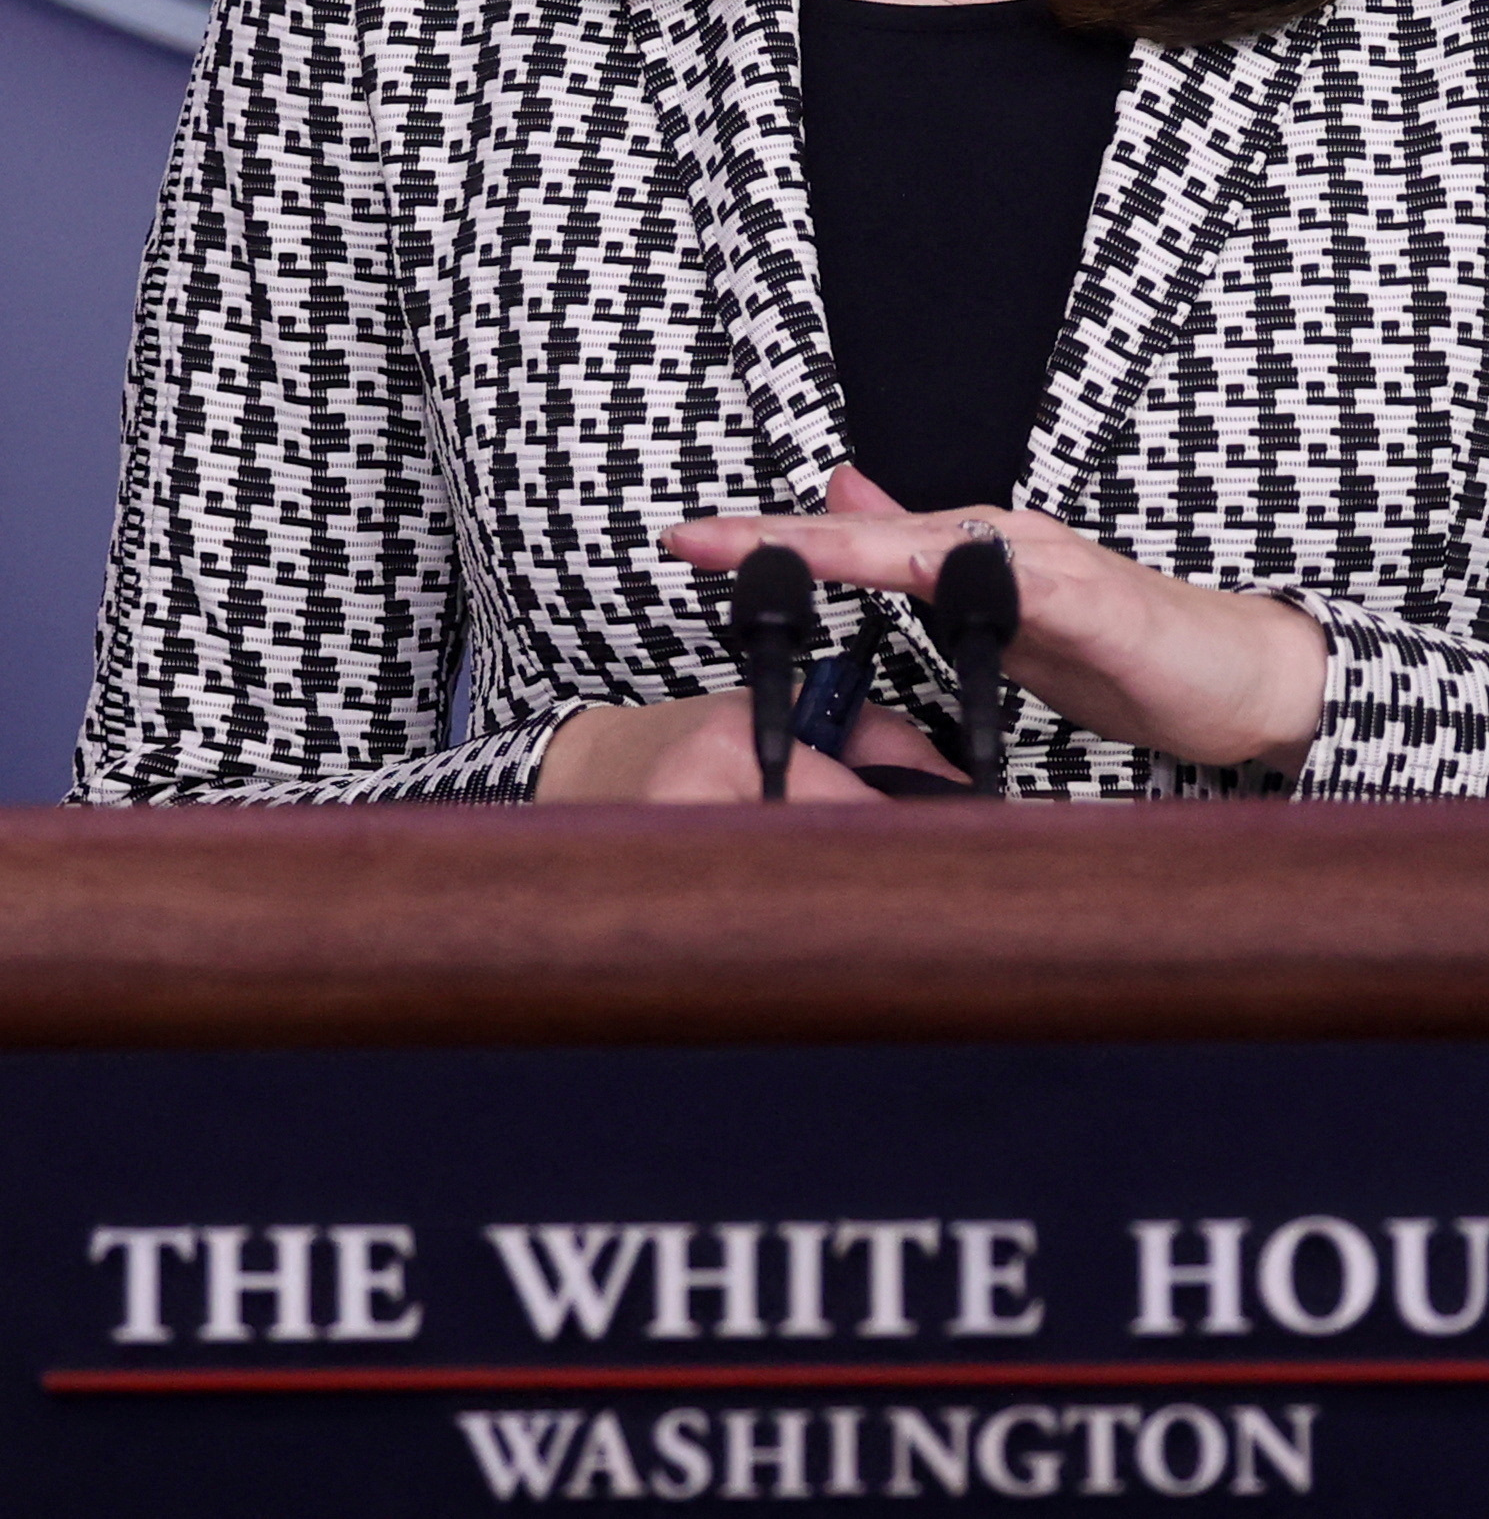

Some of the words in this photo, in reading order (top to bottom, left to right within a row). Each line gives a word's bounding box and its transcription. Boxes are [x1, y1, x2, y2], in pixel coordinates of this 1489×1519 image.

[88, 1222, 423, 1343] THE
[484, 1218, 1045, 1340] WHITE
[455, 1404, 1318, 1502] WASHINGTON
